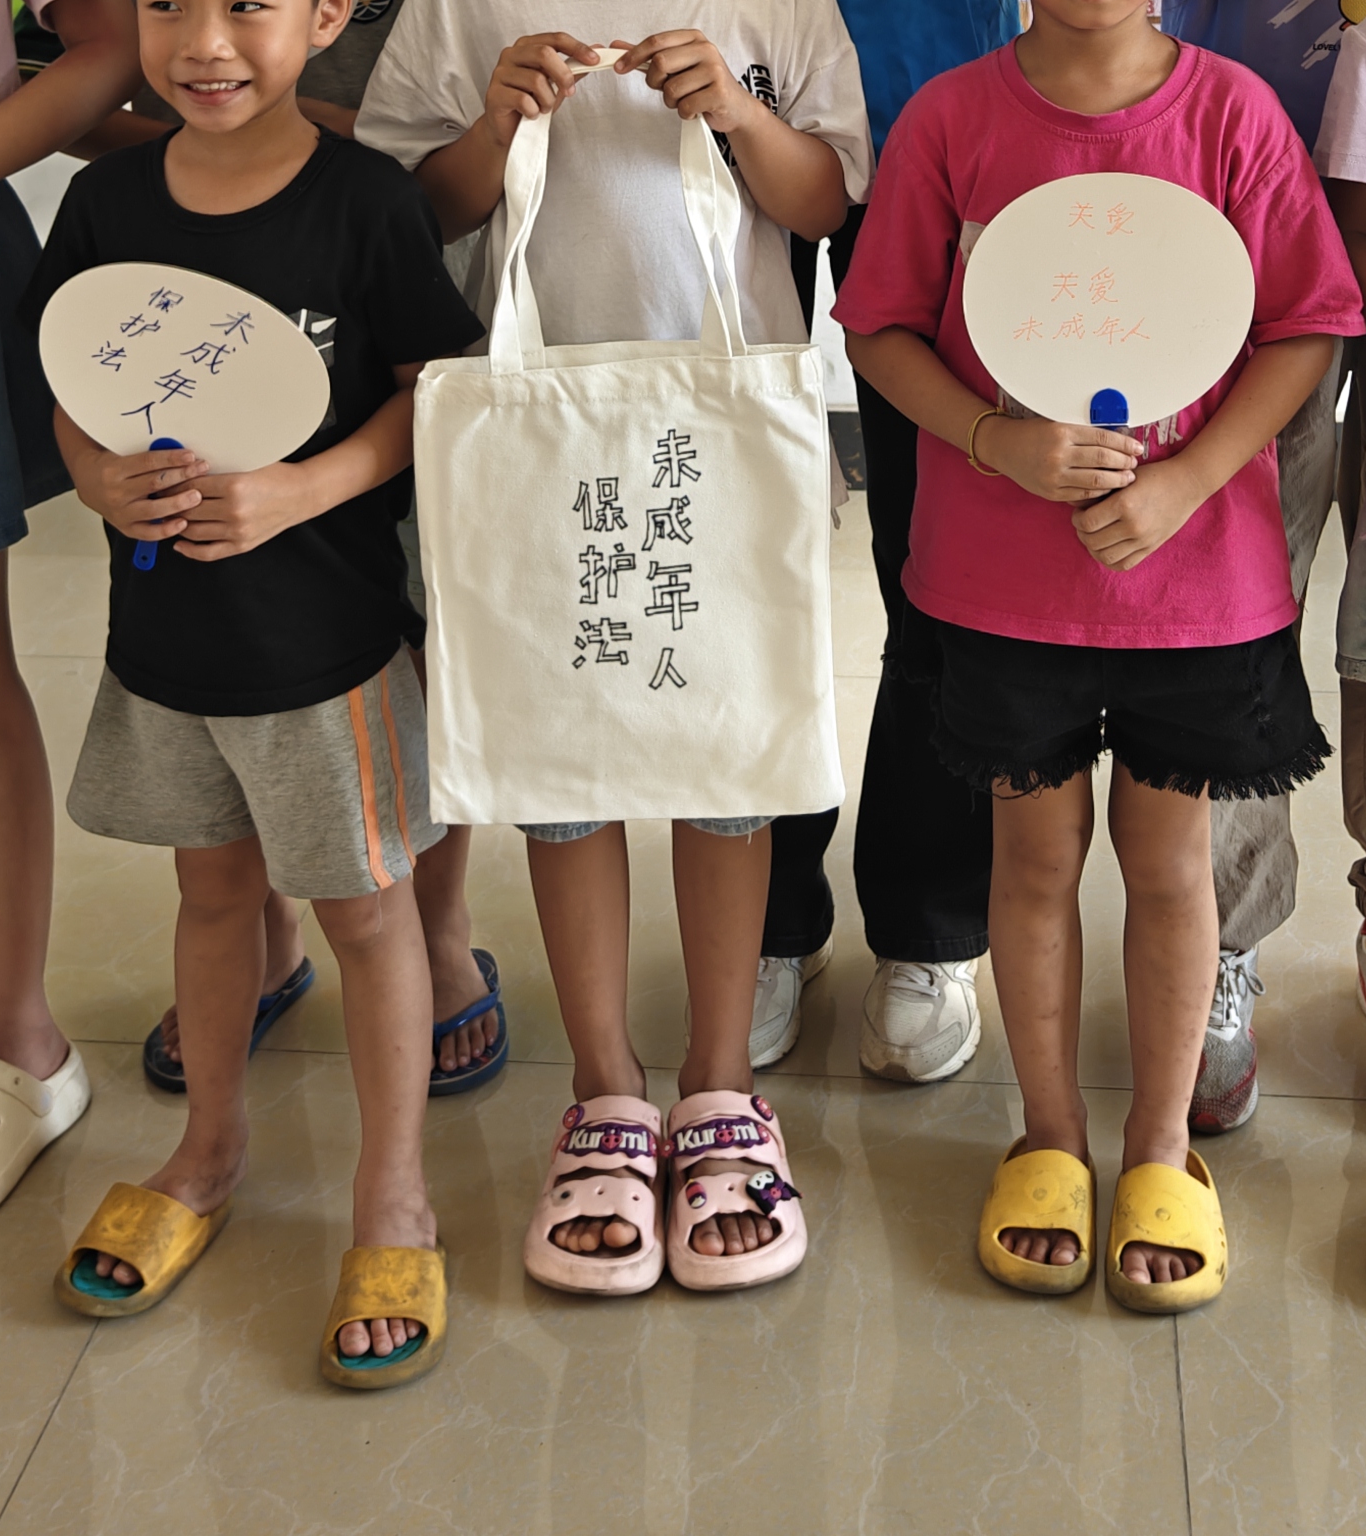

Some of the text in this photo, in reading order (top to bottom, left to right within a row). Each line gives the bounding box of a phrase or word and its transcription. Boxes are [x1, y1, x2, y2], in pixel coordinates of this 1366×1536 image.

[91, 285, 184, 371] 保护法
[1012, 312, 1151, 345] 未成年人
[1050, 266, 1119, 305] 关爱
[571, 476, 636, 670] 保护法
[641, 428, 702, 691] 未成年人
